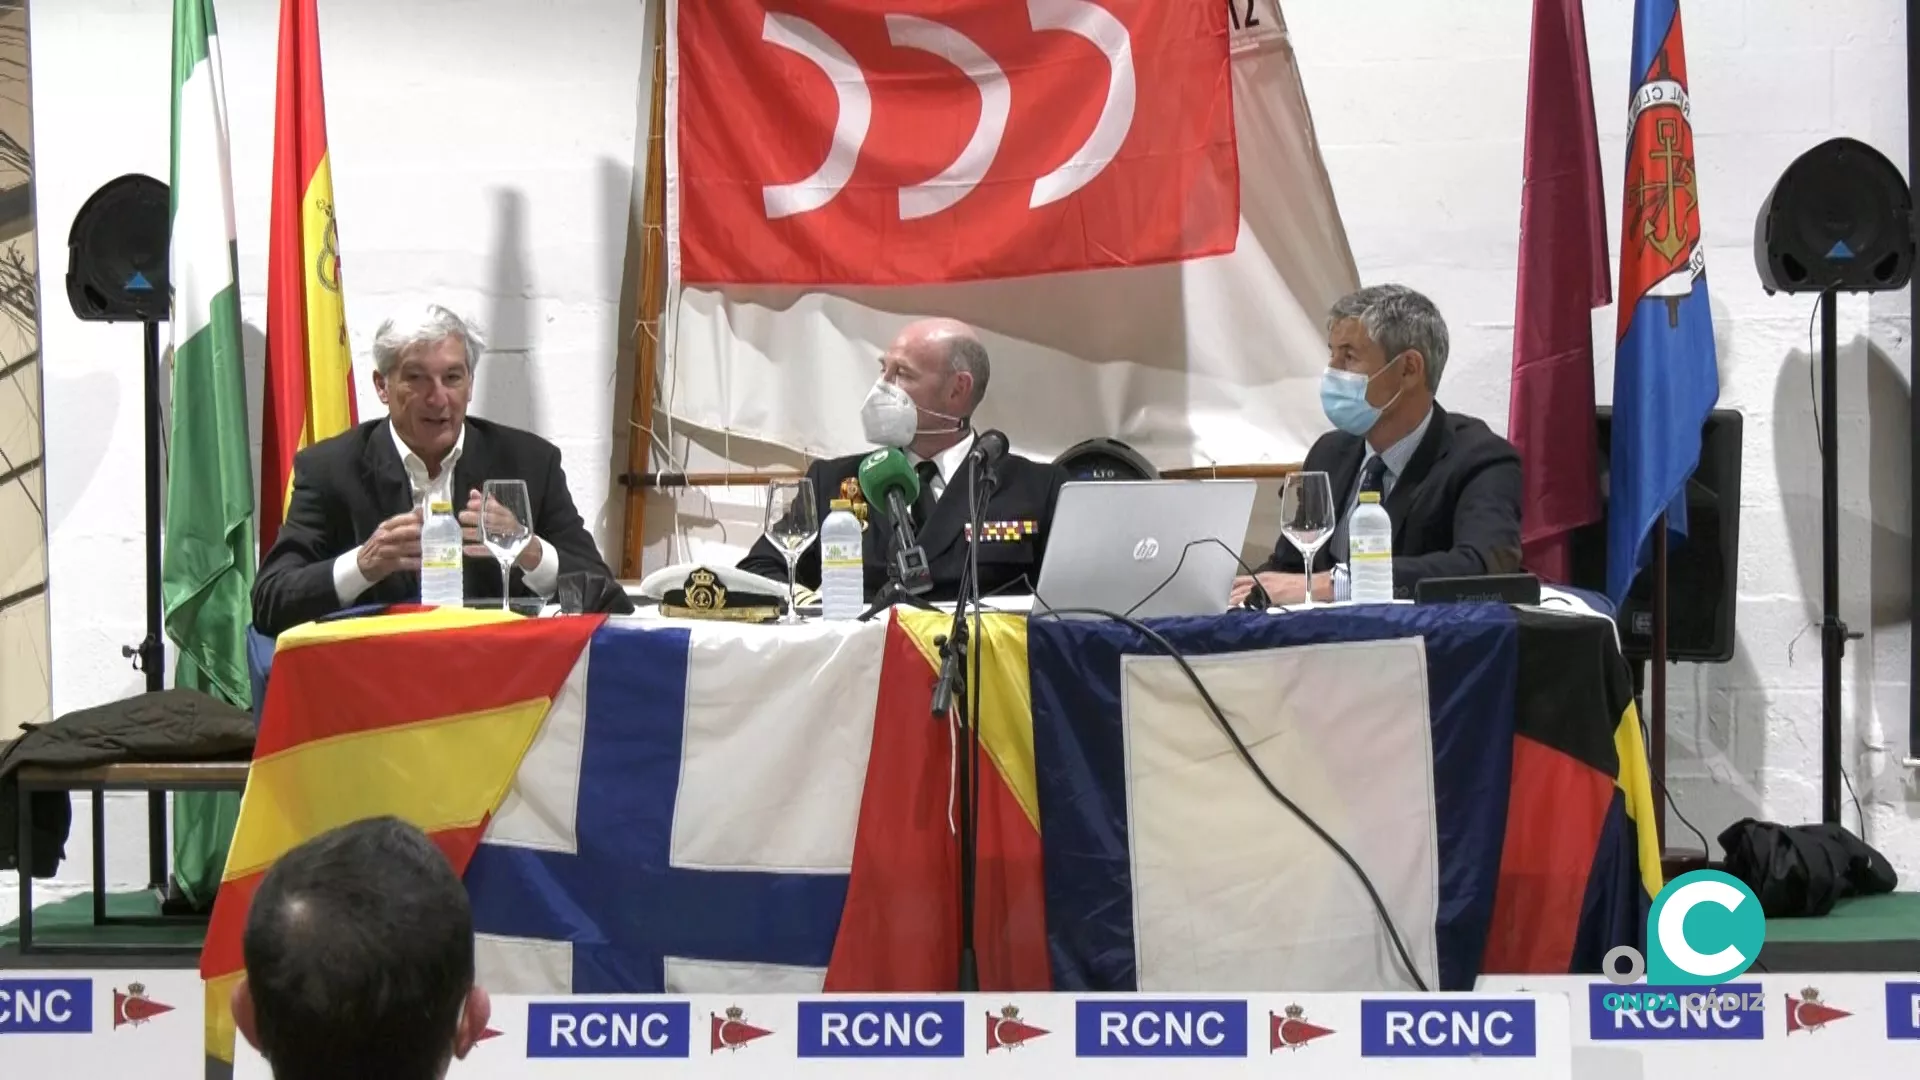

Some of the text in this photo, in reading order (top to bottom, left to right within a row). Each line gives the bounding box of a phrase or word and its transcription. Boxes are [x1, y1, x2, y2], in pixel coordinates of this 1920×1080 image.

[550, 1012, 669, 1046] RCNC
[821, 1011, 943, 1046] RCNC
[1100, 1011, 1225, 1046] RCNC
[1386, 1010, 1514, 1046] RCNC
